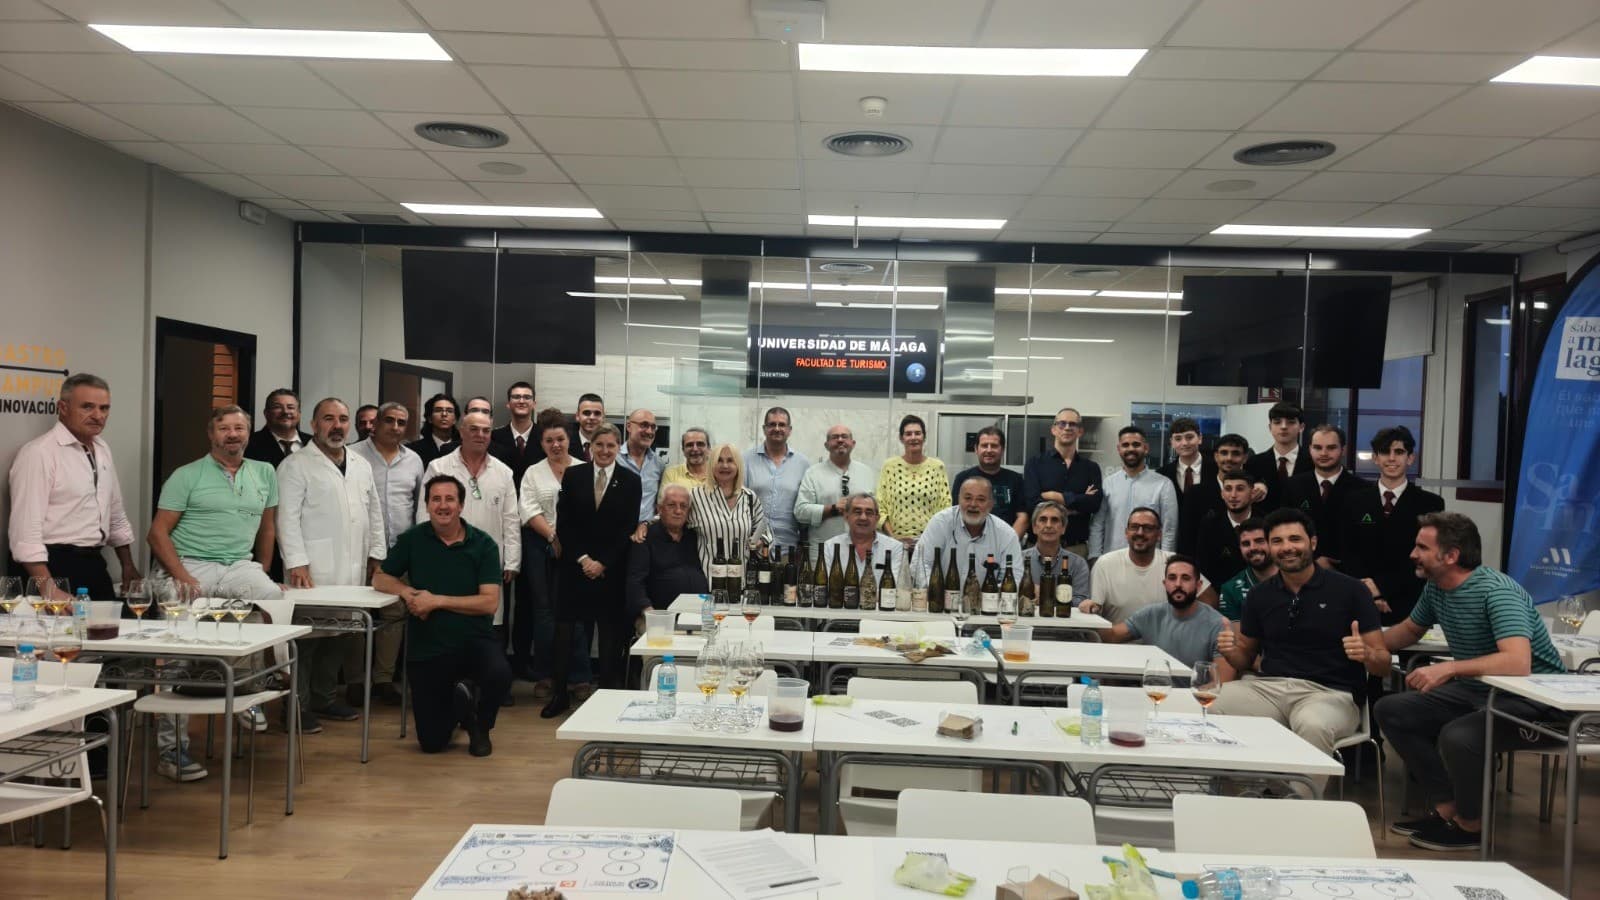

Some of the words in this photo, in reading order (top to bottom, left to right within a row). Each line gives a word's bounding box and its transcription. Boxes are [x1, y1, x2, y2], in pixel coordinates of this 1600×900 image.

[758, 338, 846, 350] UNIVERSIDAD
[850, 341, 866, 351] DE
[0, 343, 66, 367] ASTRO
[796, 358, 834, 367] FACULTAD
[836, 359, 848, 368] DE
[851, 360, 887, 369] TURISMO
[0, 398, 59, 415] NOVACIÓ
